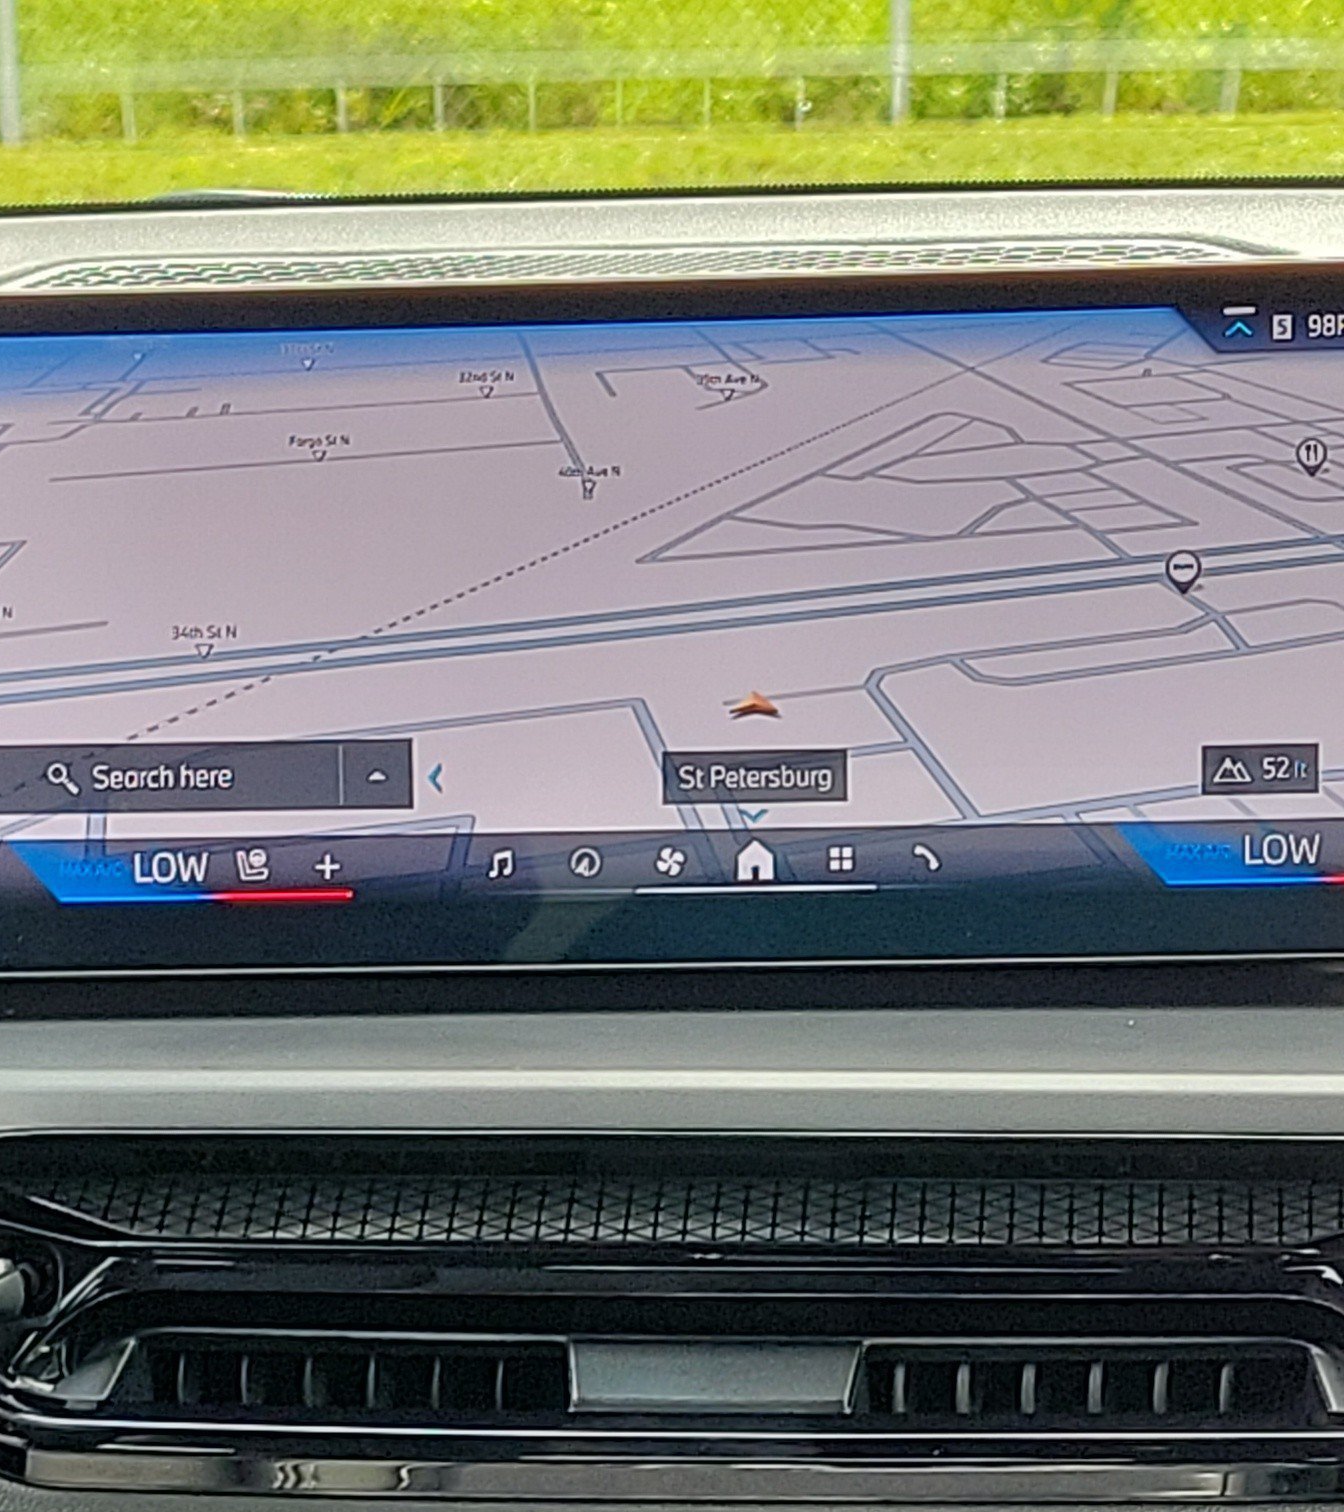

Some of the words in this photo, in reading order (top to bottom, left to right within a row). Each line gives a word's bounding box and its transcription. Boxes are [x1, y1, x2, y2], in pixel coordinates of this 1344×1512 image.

[325, 434, 337, 446] St
[340, 433, 350, 446] N
[3, 607, 13, 619] N
[206, 625, 221, 639] St
[225, 624, 237, 639] N
[92, 764, 174, 790] Search
[179, 763, 234, 789] here
[679, 765, 705, 790] St
[709, 764, 833, 792] Petersburg
[1262, 757, 1291, 781] 52
[1243, 833, 1321, 865] LOW
[133, 850, 210, 884] LOW
